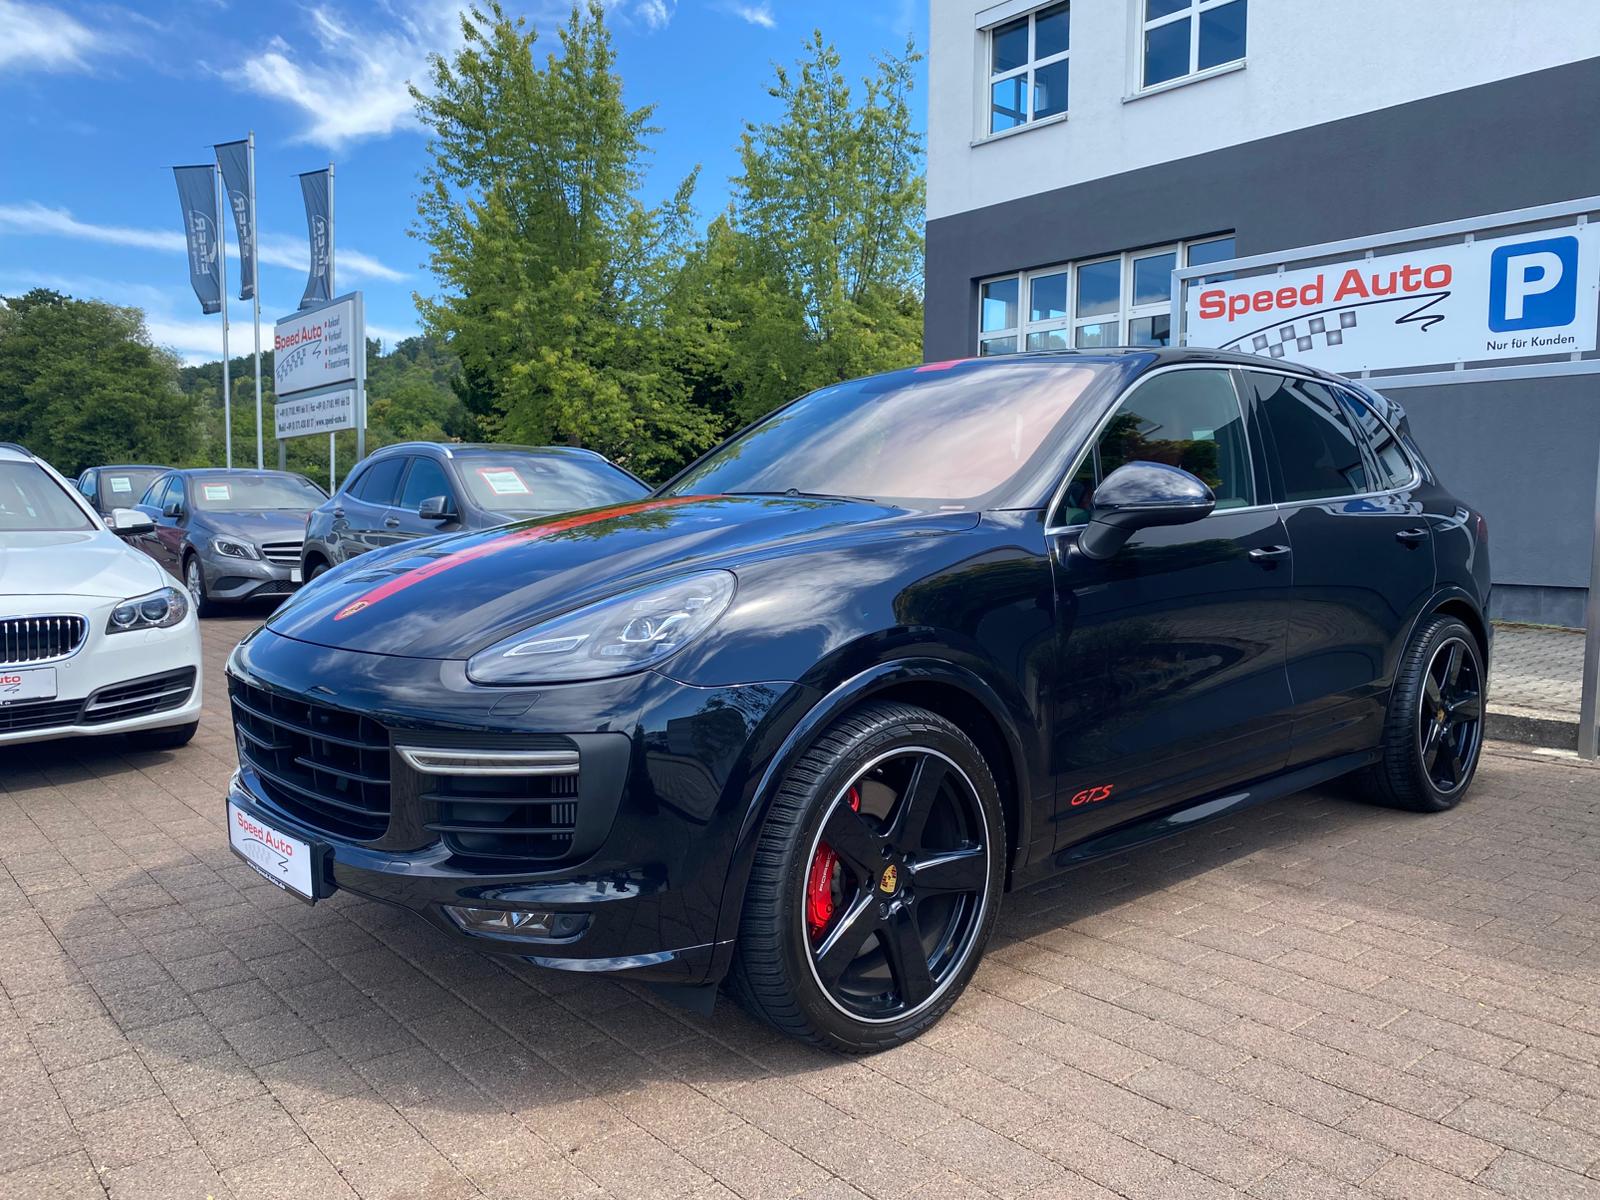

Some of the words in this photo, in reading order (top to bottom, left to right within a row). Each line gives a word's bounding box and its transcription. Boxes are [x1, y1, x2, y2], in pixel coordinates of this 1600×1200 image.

[1199, 274, 1325, 322] Speed
[1333, 263, 1453, 302] Auto
[1504, 251, 1564, 321] P
[275, 329, 300, 352] Speed
[301, 325, 322, 343] Auto
[1486, 340, 1508, 351] Nur
[1511, 337, 1528, 349] für
[1531, 333, 1575, 347] Kunden
[1071, 783, 1115, 806] GTS
[236, 812, 264, 840] Speed
[265, 831, 293, 856] Auto
